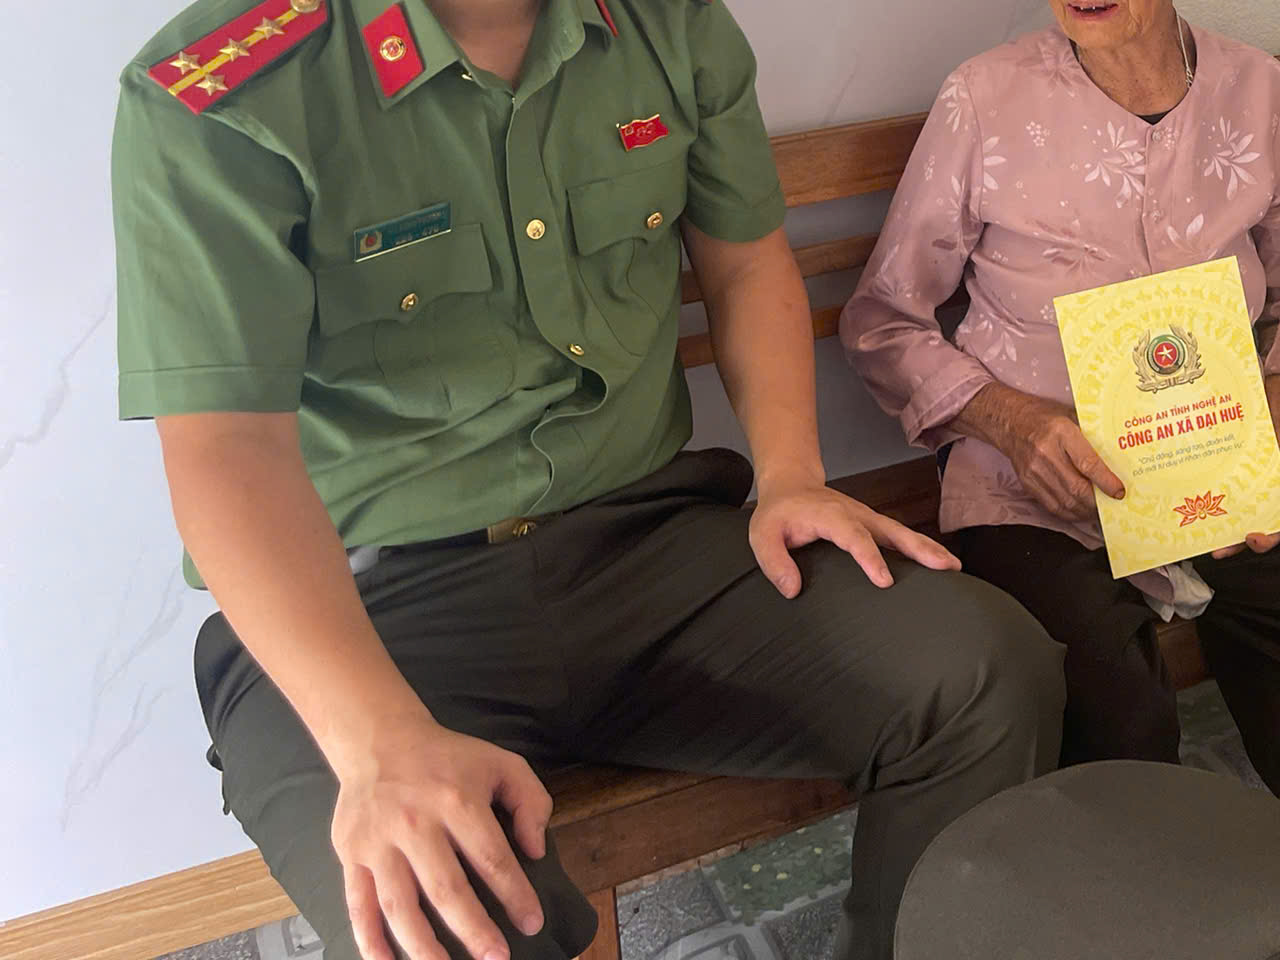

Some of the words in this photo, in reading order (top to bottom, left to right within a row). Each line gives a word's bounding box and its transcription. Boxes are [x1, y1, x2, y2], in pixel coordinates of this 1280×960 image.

[1118, 429, 1153, 450] CÔNG
[1156, 423, 1174, 441] AN
[1176, 416, 1194, 435] XÃ
[1195, 411, 1217, 430] ĐẠI
[1219, 402, 1244, 422] HUỆ
[1124, 415, 1153, 429] CÔNG
[1155, 410, 1168, 421] AN
[1191, 395, 1217, 411] NGHỆ
[1219, 394, 1232, 404] AN
